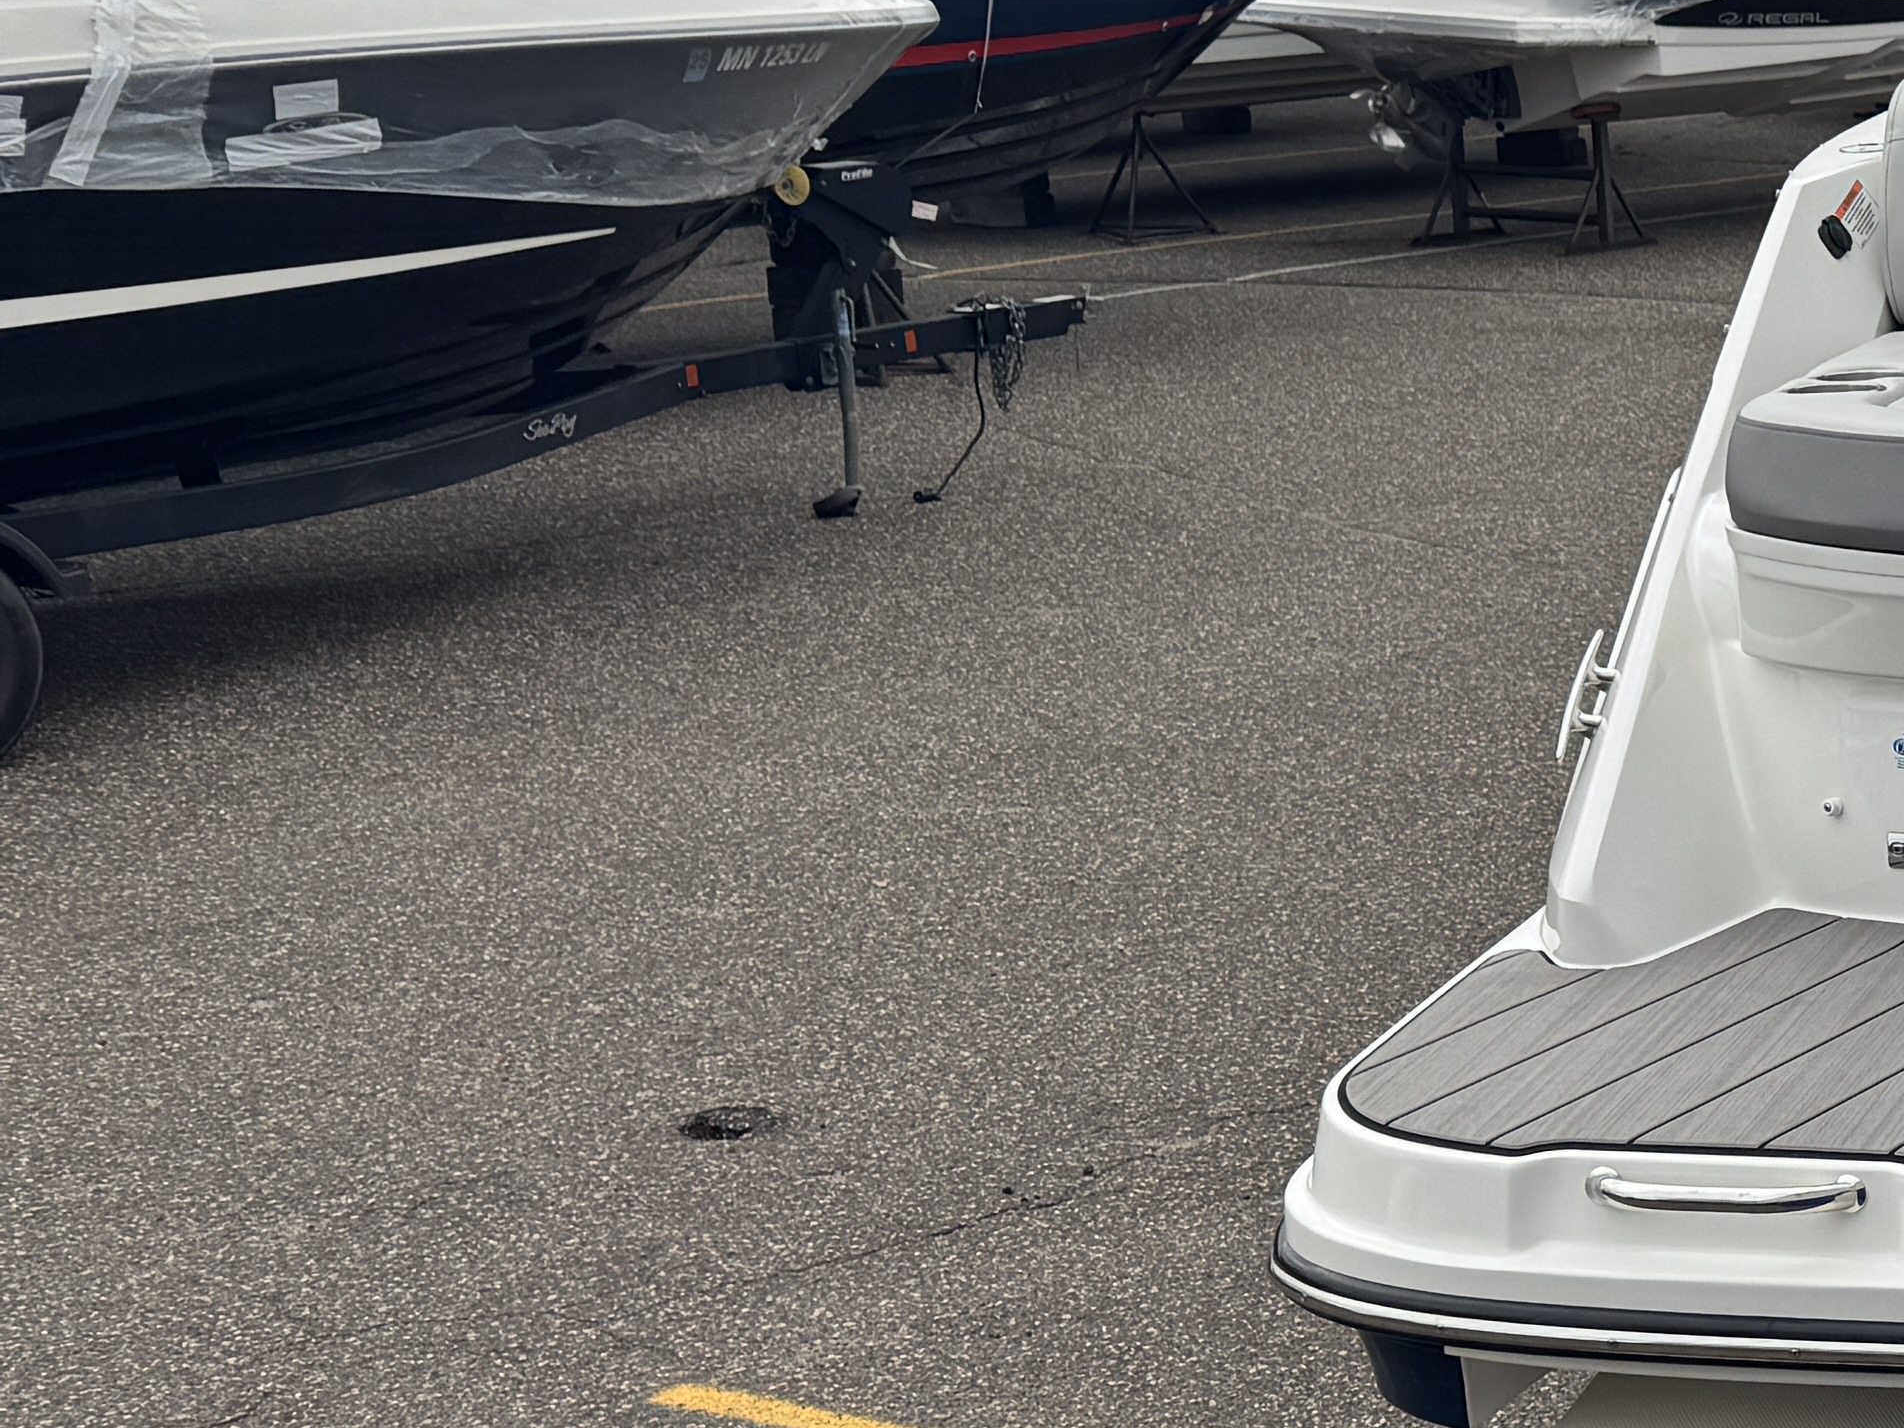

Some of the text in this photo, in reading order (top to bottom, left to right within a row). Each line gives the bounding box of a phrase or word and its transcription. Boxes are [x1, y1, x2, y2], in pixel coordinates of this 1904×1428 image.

[1747, 12, 1830, 25] REGAL
[717, 46, 760, 72] MN
[523, 412, 577, 441] Sea Ray
